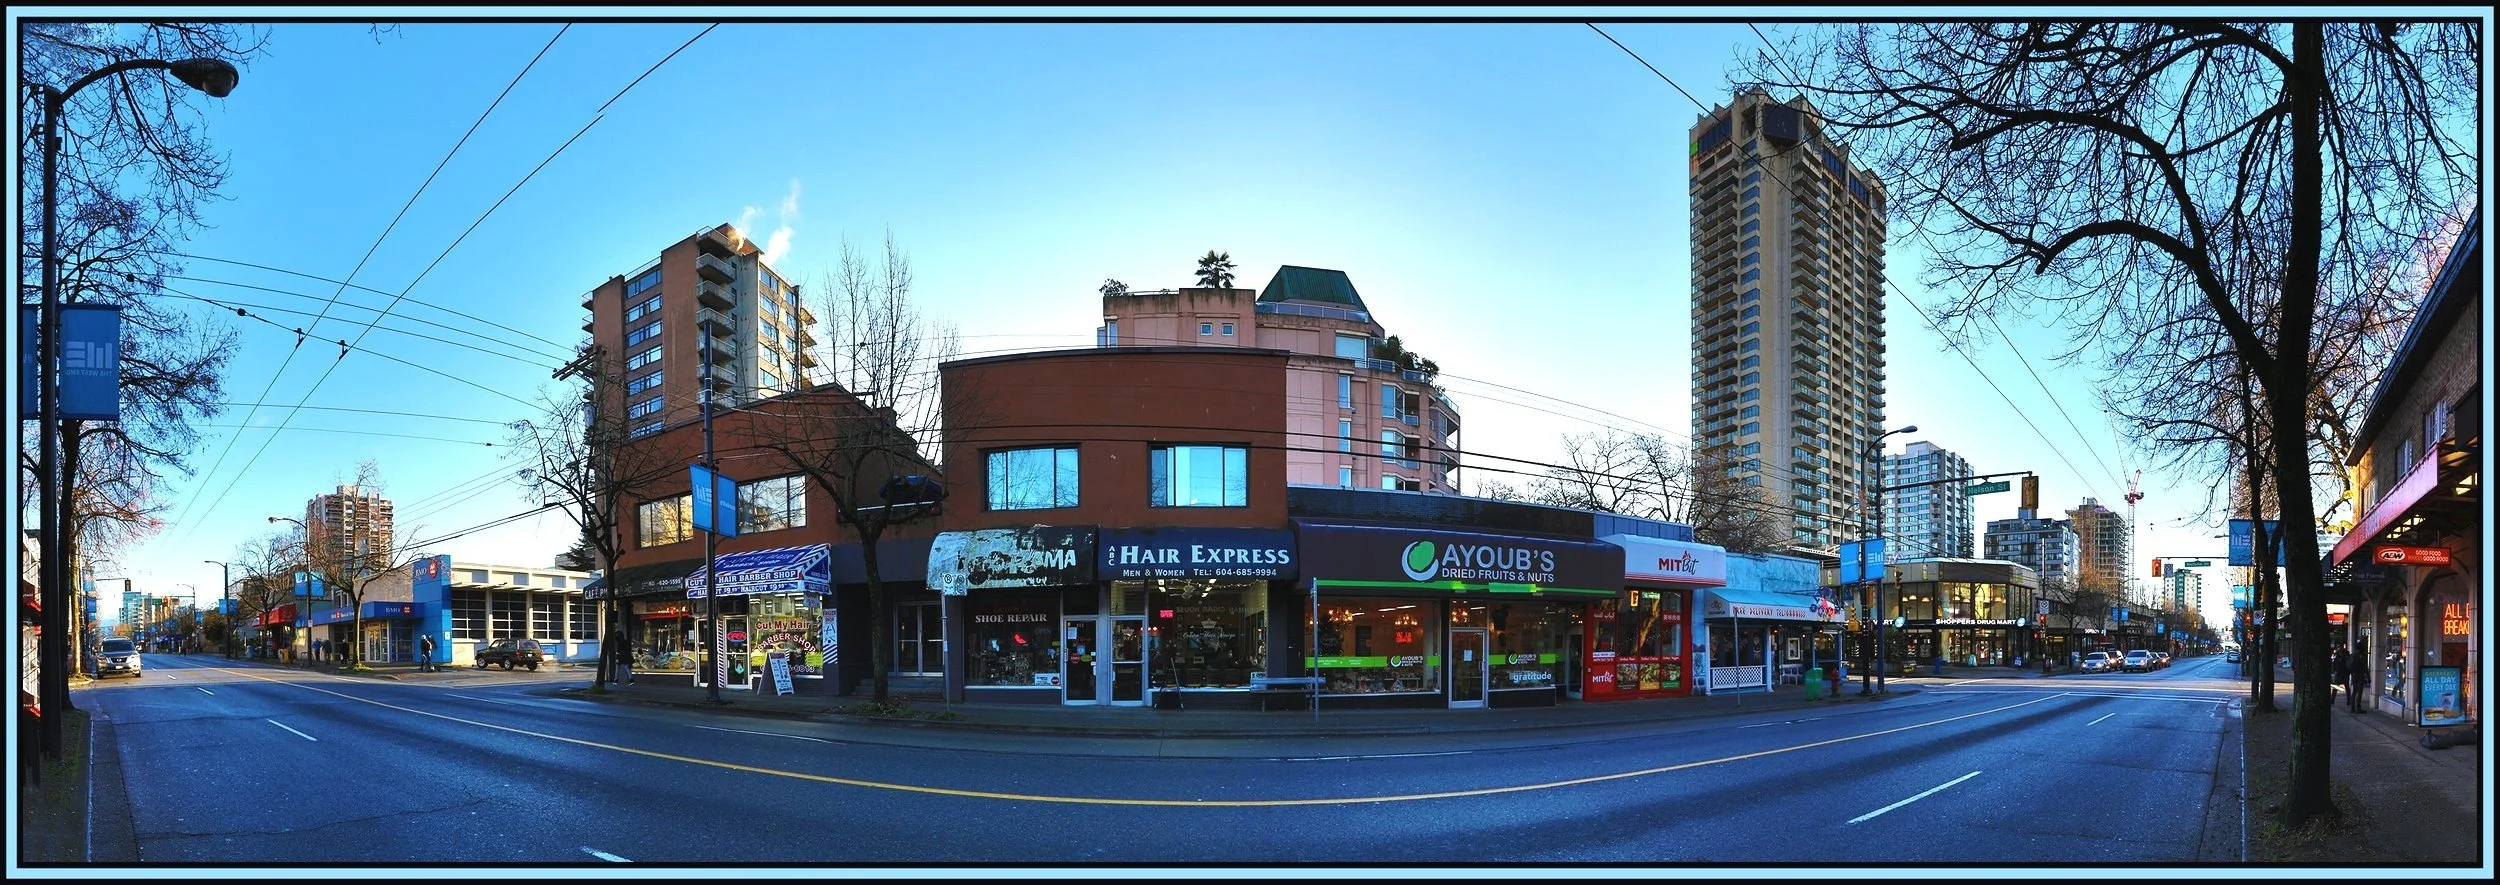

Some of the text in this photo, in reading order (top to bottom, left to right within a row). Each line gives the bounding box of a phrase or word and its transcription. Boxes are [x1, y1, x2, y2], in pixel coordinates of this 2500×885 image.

[1967, 483, 2007, 495] Nelson St
[1120, 544, 1290, 565] HAIR EXPRESS
[1442, 543, 1555, 573] AYOUB'S
[2381, 551, 2404, 560] A&W
[718, 575, 737, 584] HAIR
[739, 572, 771, 582] BARBER
[773, 570, 796, 579] SHOP
[1123, 568, 1277, 577] MEN & WOMEN TEL: 604-685-9994
[1442, 568, 1555, 583] DRIED FRUITS & NUTS
[1749, 607, 1774, 616] DELIVERY
[2445, 603, 2463, 618] ALL
[975, 614, 1048, 623] SHOE REPAIR
[756, 620, 811, 631] Cut My Hair
[757, 633, 817, 653] BARBER SHOP
[1513, 671, 1552, 683] gratitude
